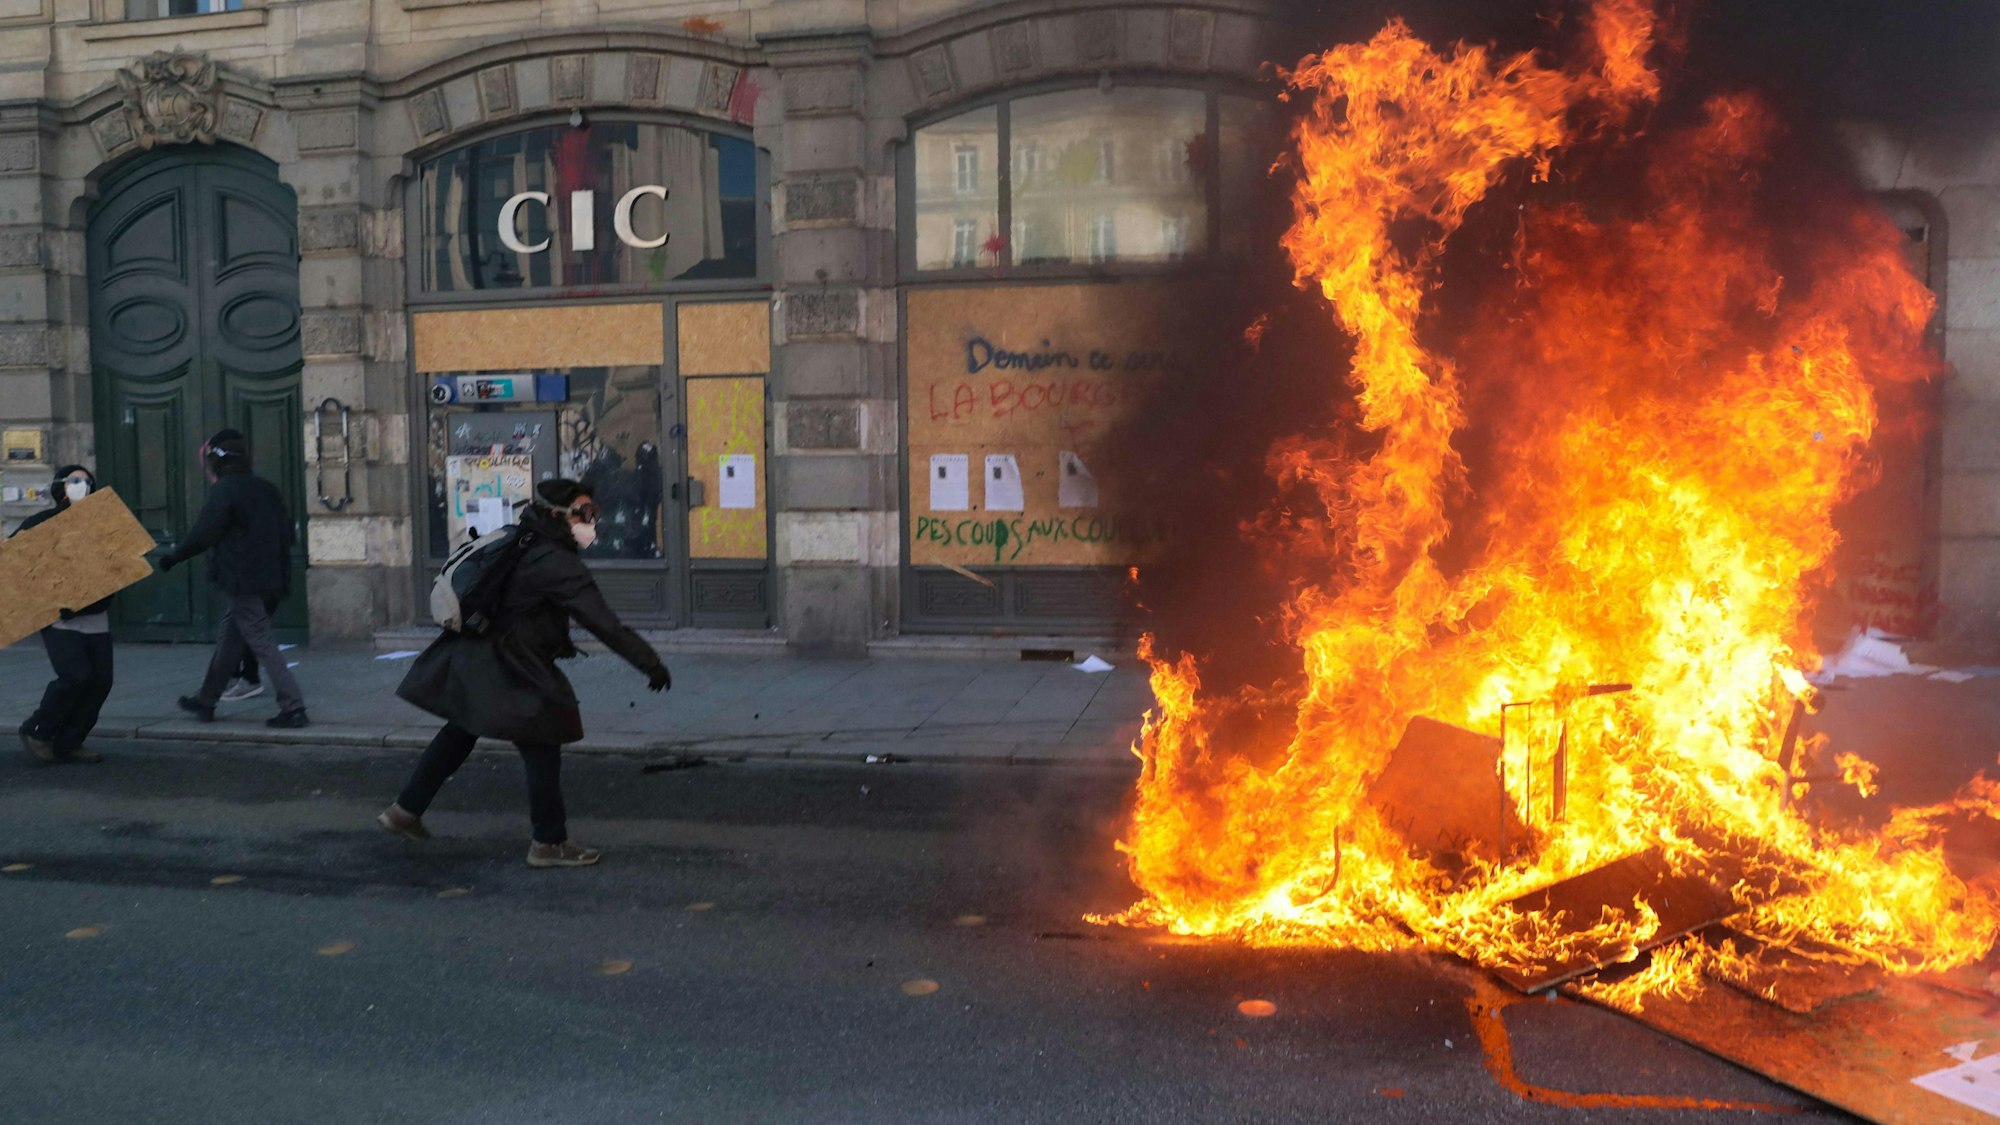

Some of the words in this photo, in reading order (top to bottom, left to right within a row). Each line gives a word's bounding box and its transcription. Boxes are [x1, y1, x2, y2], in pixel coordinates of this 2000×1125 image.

[498, 184, 670, 254] CIC
[967, 337, 1078, 374] Demain
[928, 382, 977, 420] LA
[956, 517, 1022, 561] COUPS
[1027, 517, 1068, 542] AUX
